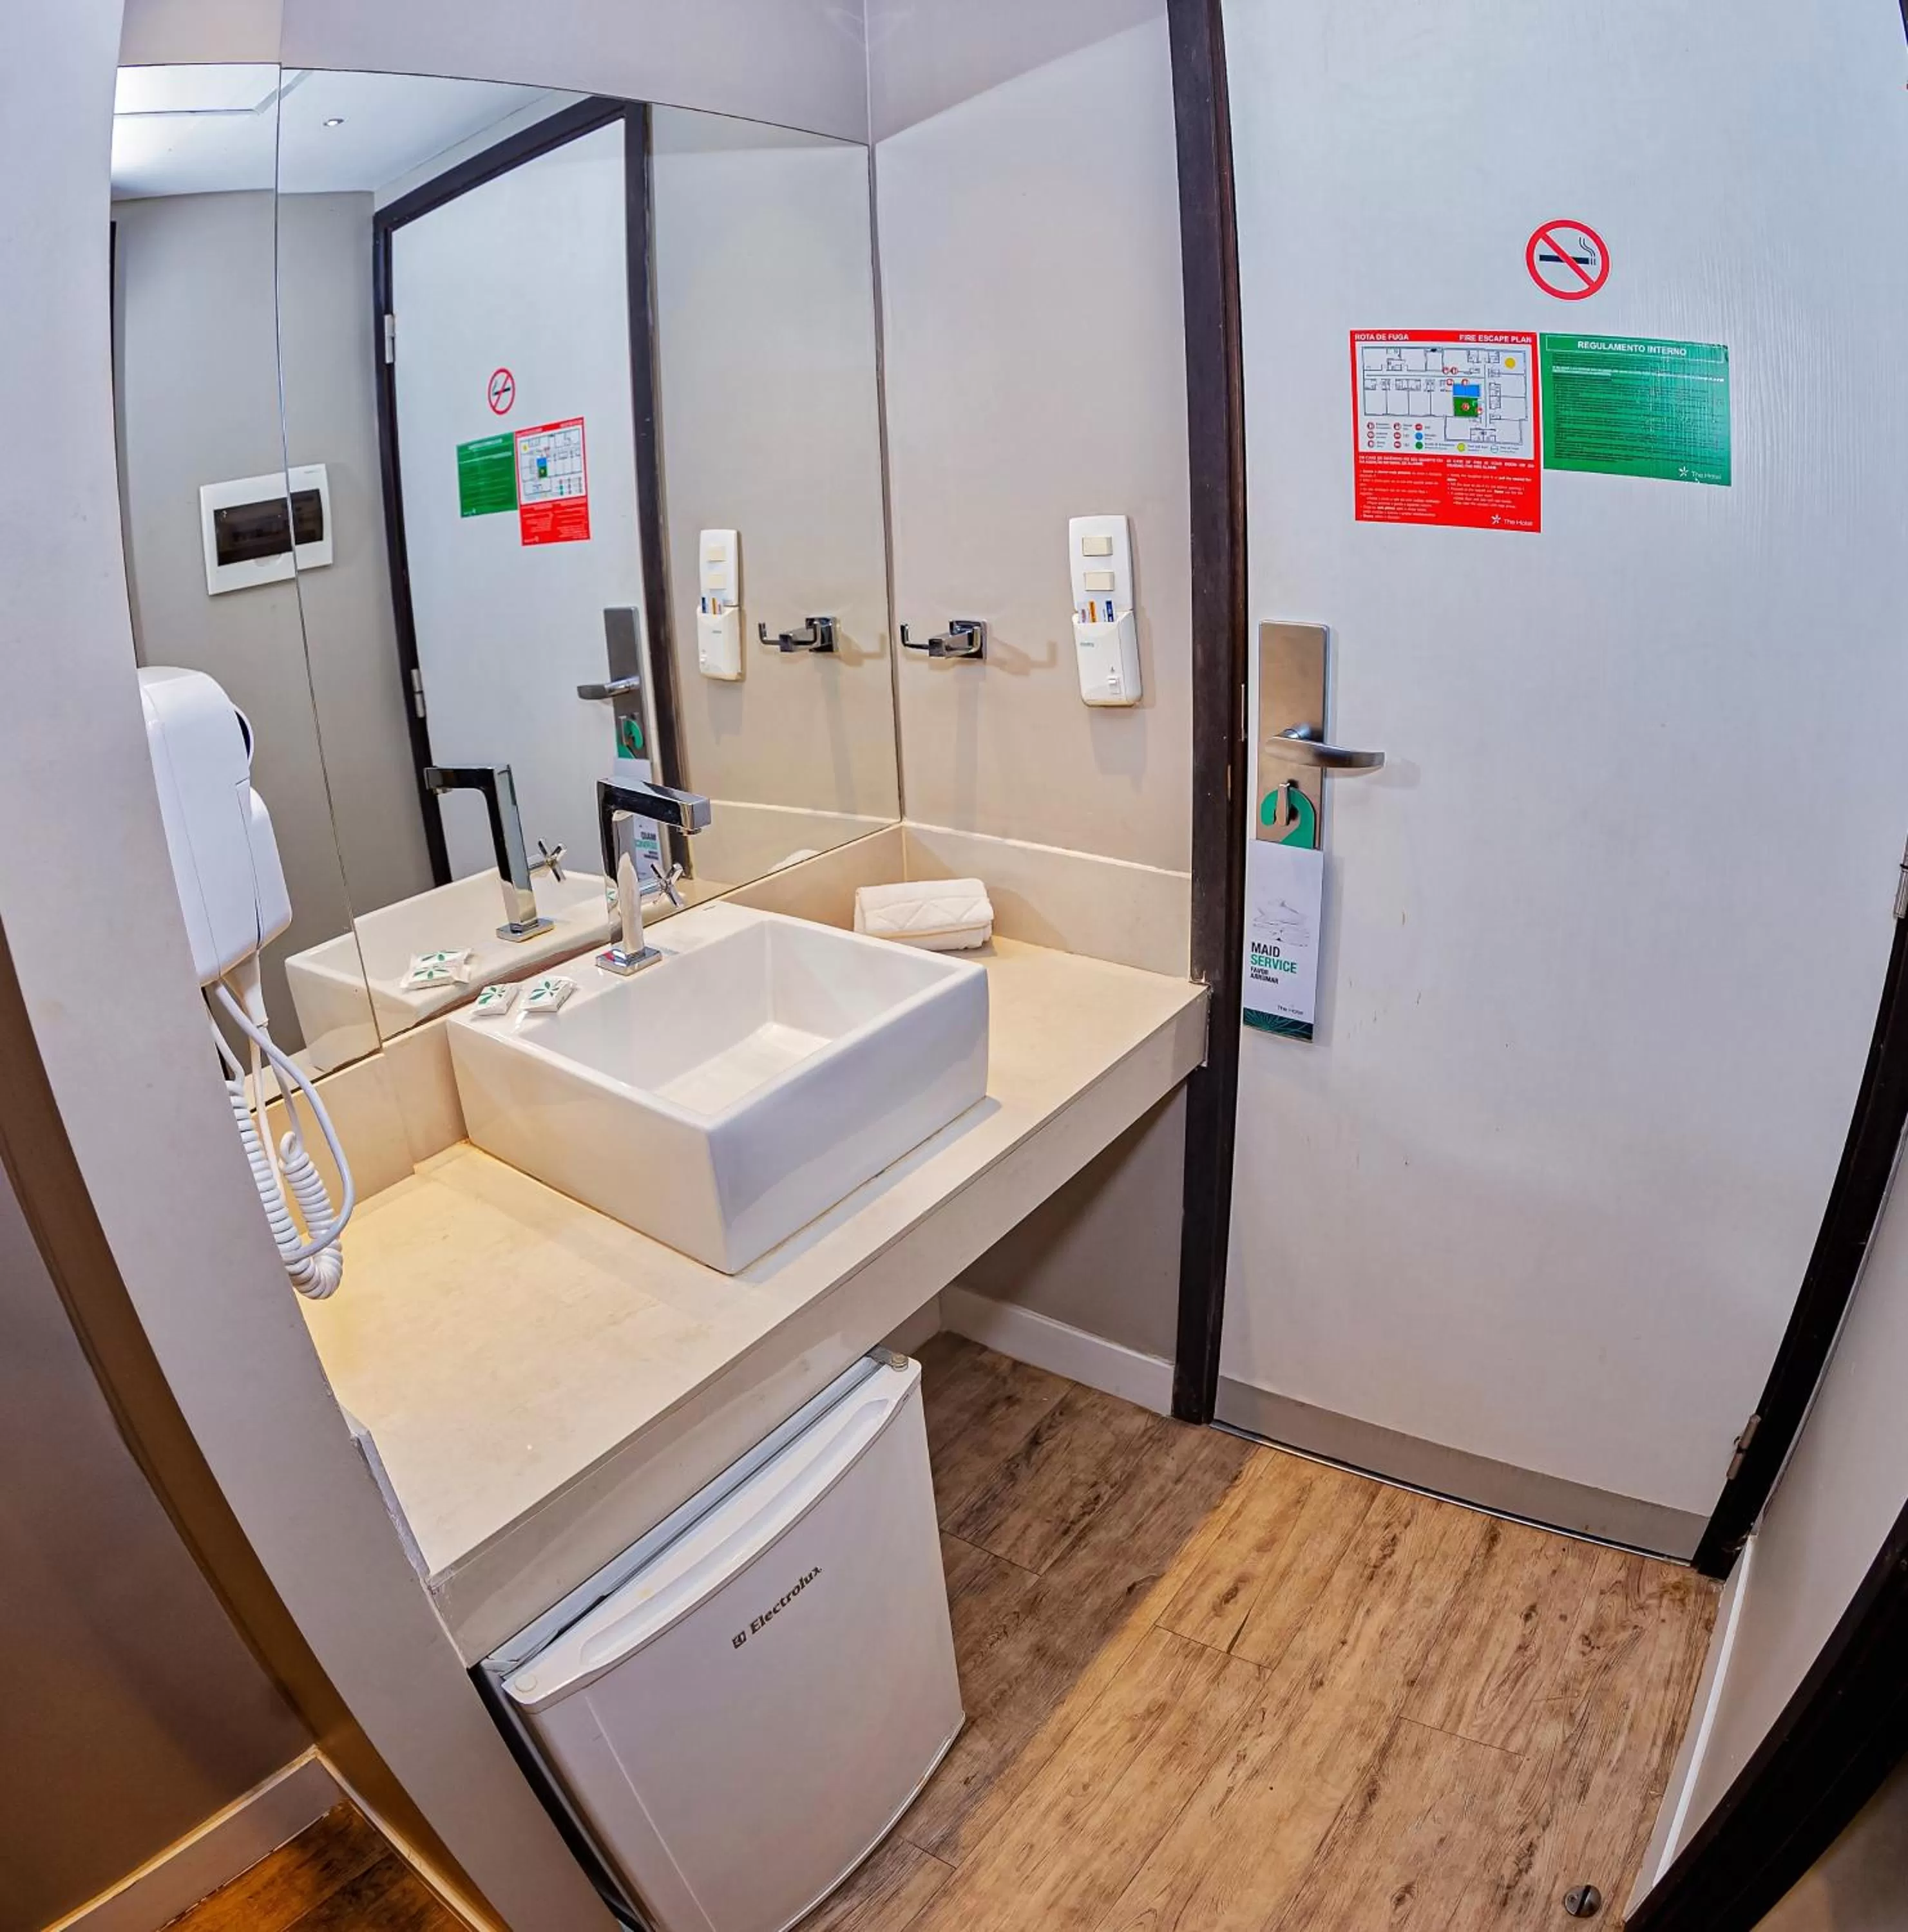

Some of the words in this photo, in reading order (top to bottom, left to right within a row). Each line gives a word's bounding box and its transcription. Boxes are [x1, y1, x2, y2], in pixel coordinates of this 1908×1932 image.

[1355, 332, 1375, 341] ROTA
[1478, 334, 1509, 343] ESCAPE
[1578, 341, 1646, 352] REGULAMENTO
[1647, 345, 1686, 355] INTERNO
[1251, 942, 1280, 958] MAID
[1250, 954, 1297, 974] SERVICE
[750, 1566, 822, 1634] Electrolux
